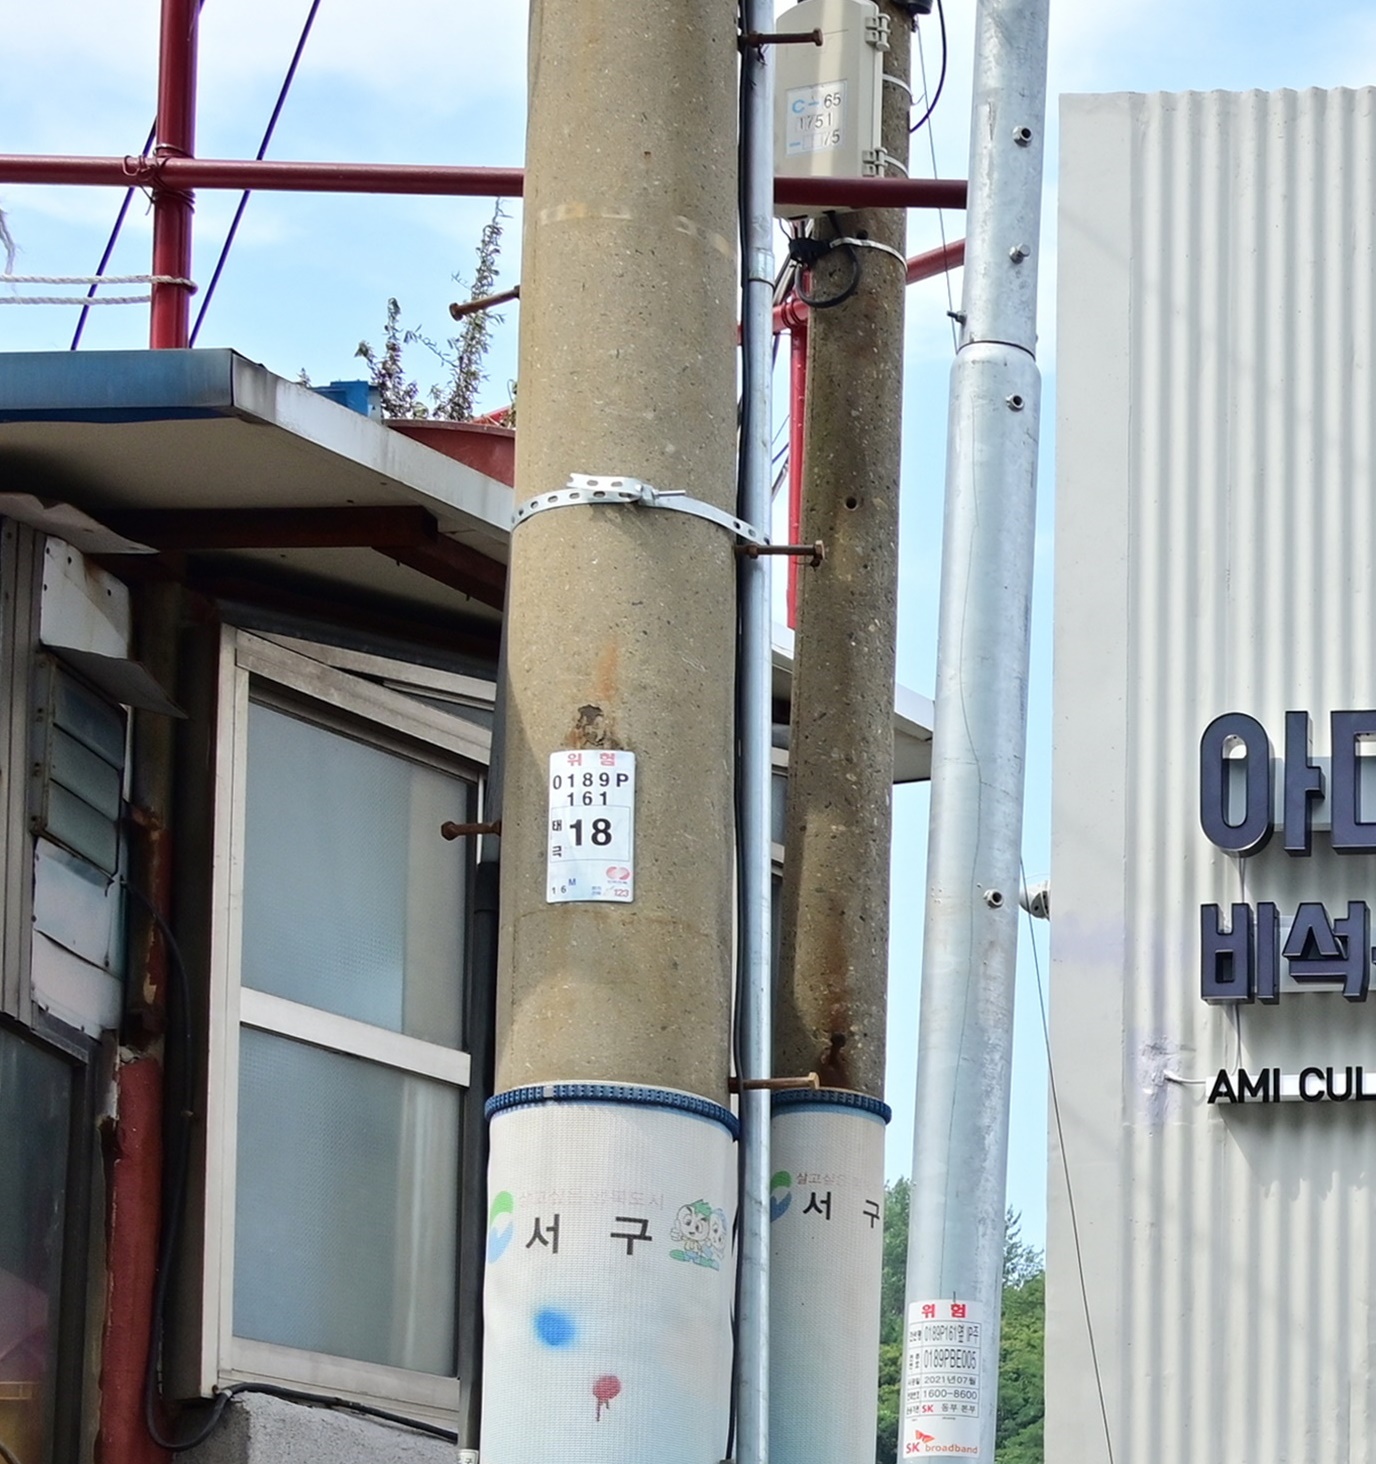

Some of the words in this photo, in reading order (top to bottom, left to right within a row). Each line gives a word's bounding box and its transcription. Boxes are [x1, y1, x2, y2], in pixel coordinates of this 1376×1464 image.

[567, 752, 616, 767] 위험
[552, 771, 630, 790] 0189P
[567, 790, 608, 806] 161
[569, 817, 613, 847] 18
[1208, 1067, 1281, 1104] AMI
[921, 1303, 966, 1319] 위험
[922, 1389, 978, 1400] 1600-8600
[921, 1404, 934, 1413] SK
[906, 1442, 920, 1455] SK
[924, 1443, 979, 1455] broadband
